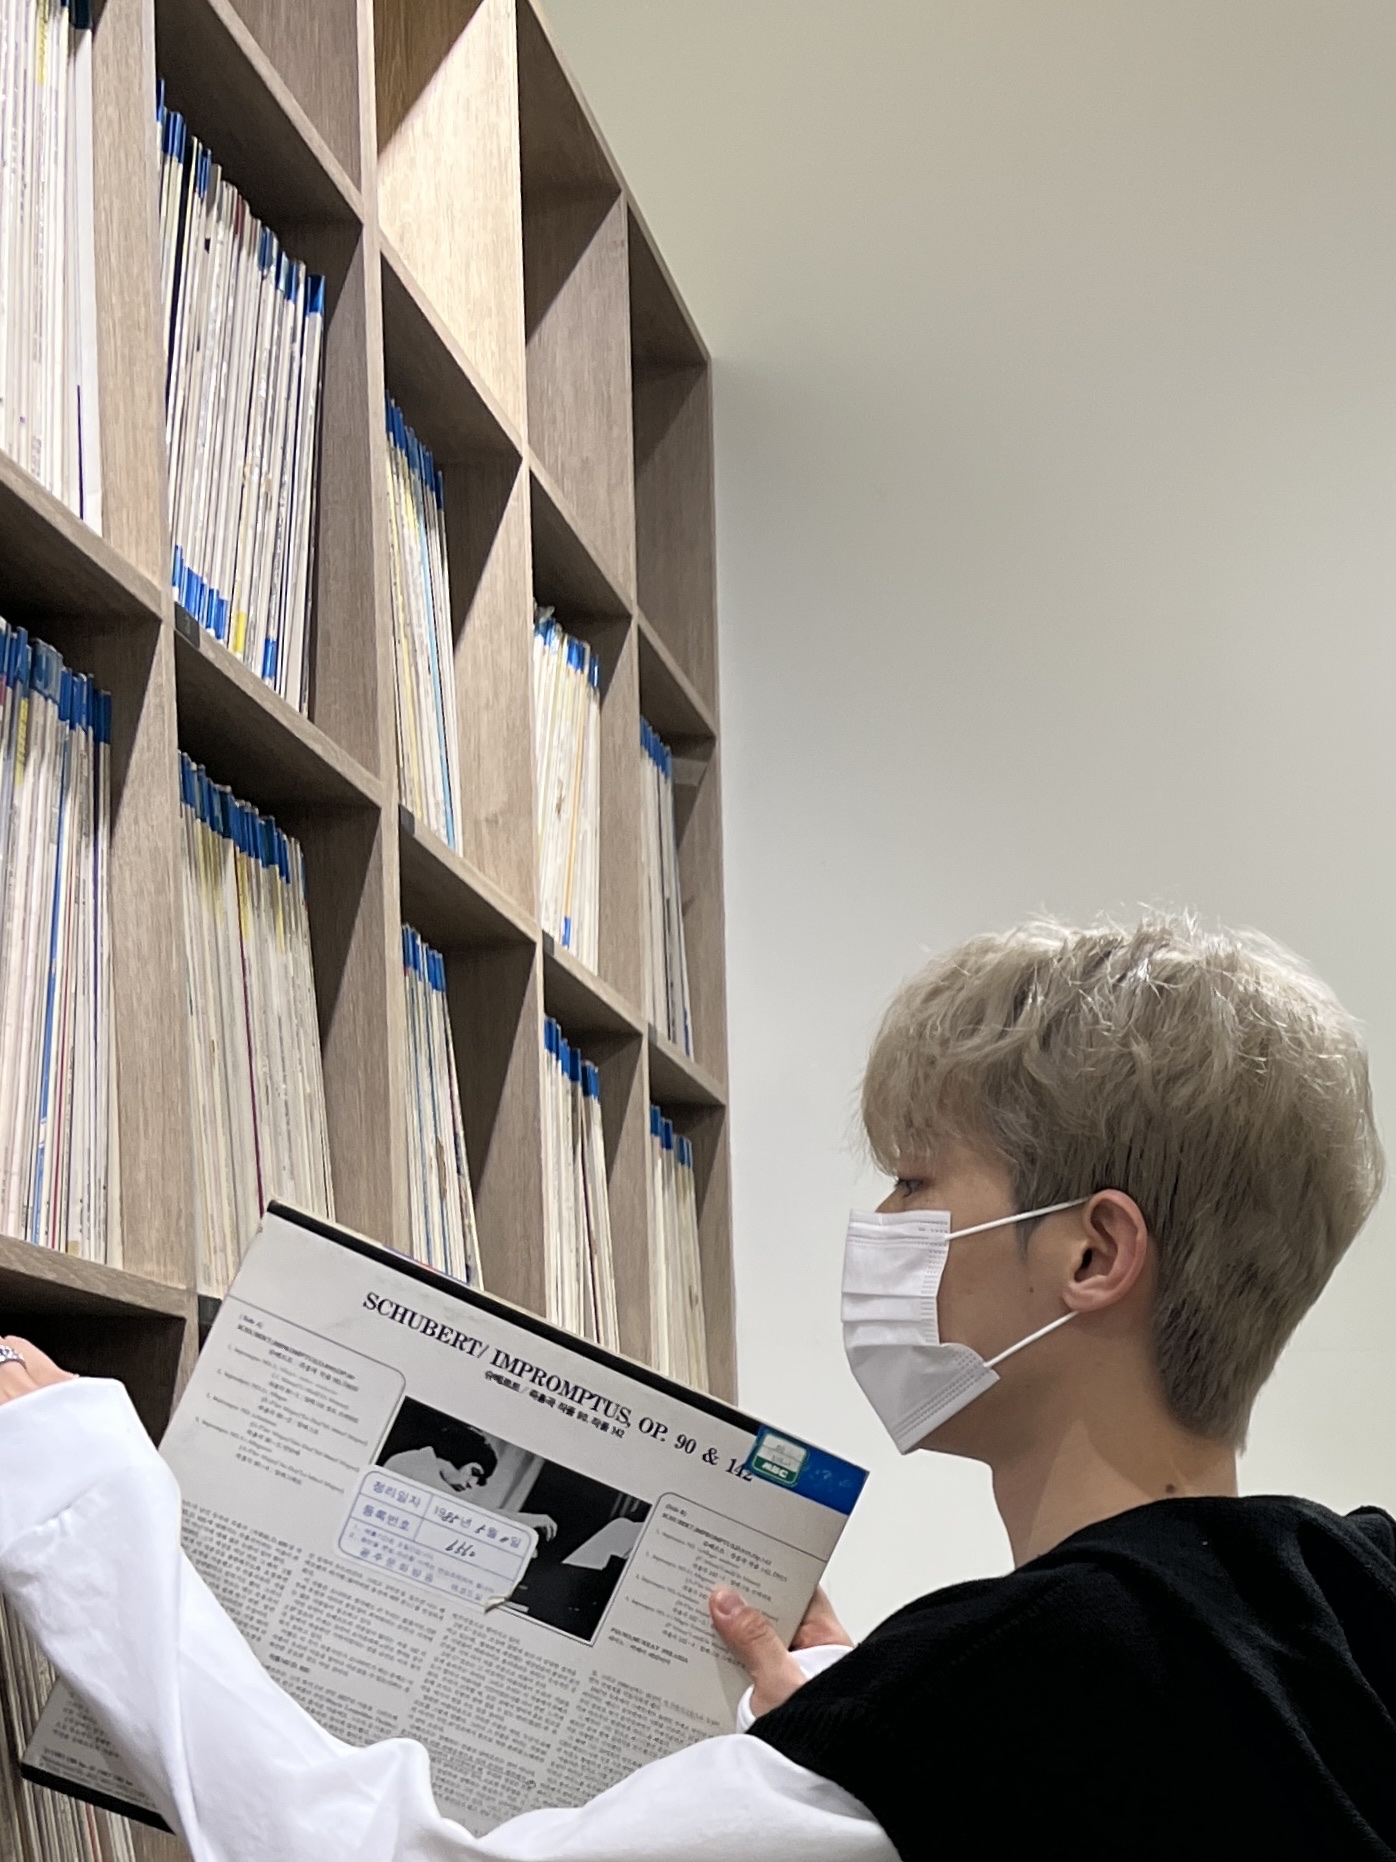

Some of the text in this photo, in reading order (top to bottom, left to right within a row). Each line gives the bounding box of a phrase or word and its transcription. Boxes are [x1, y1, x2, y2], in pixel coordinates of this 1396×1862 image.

[363, 1291, 490, 1359] SCHUBERT/
[489, 1347, 632, 1428] IMPROMPTUS,
[638, 1416, 668, 1443] OP.
[674, 1433, 698, 1455] 90
[702, 1446, 721, 1466] &
